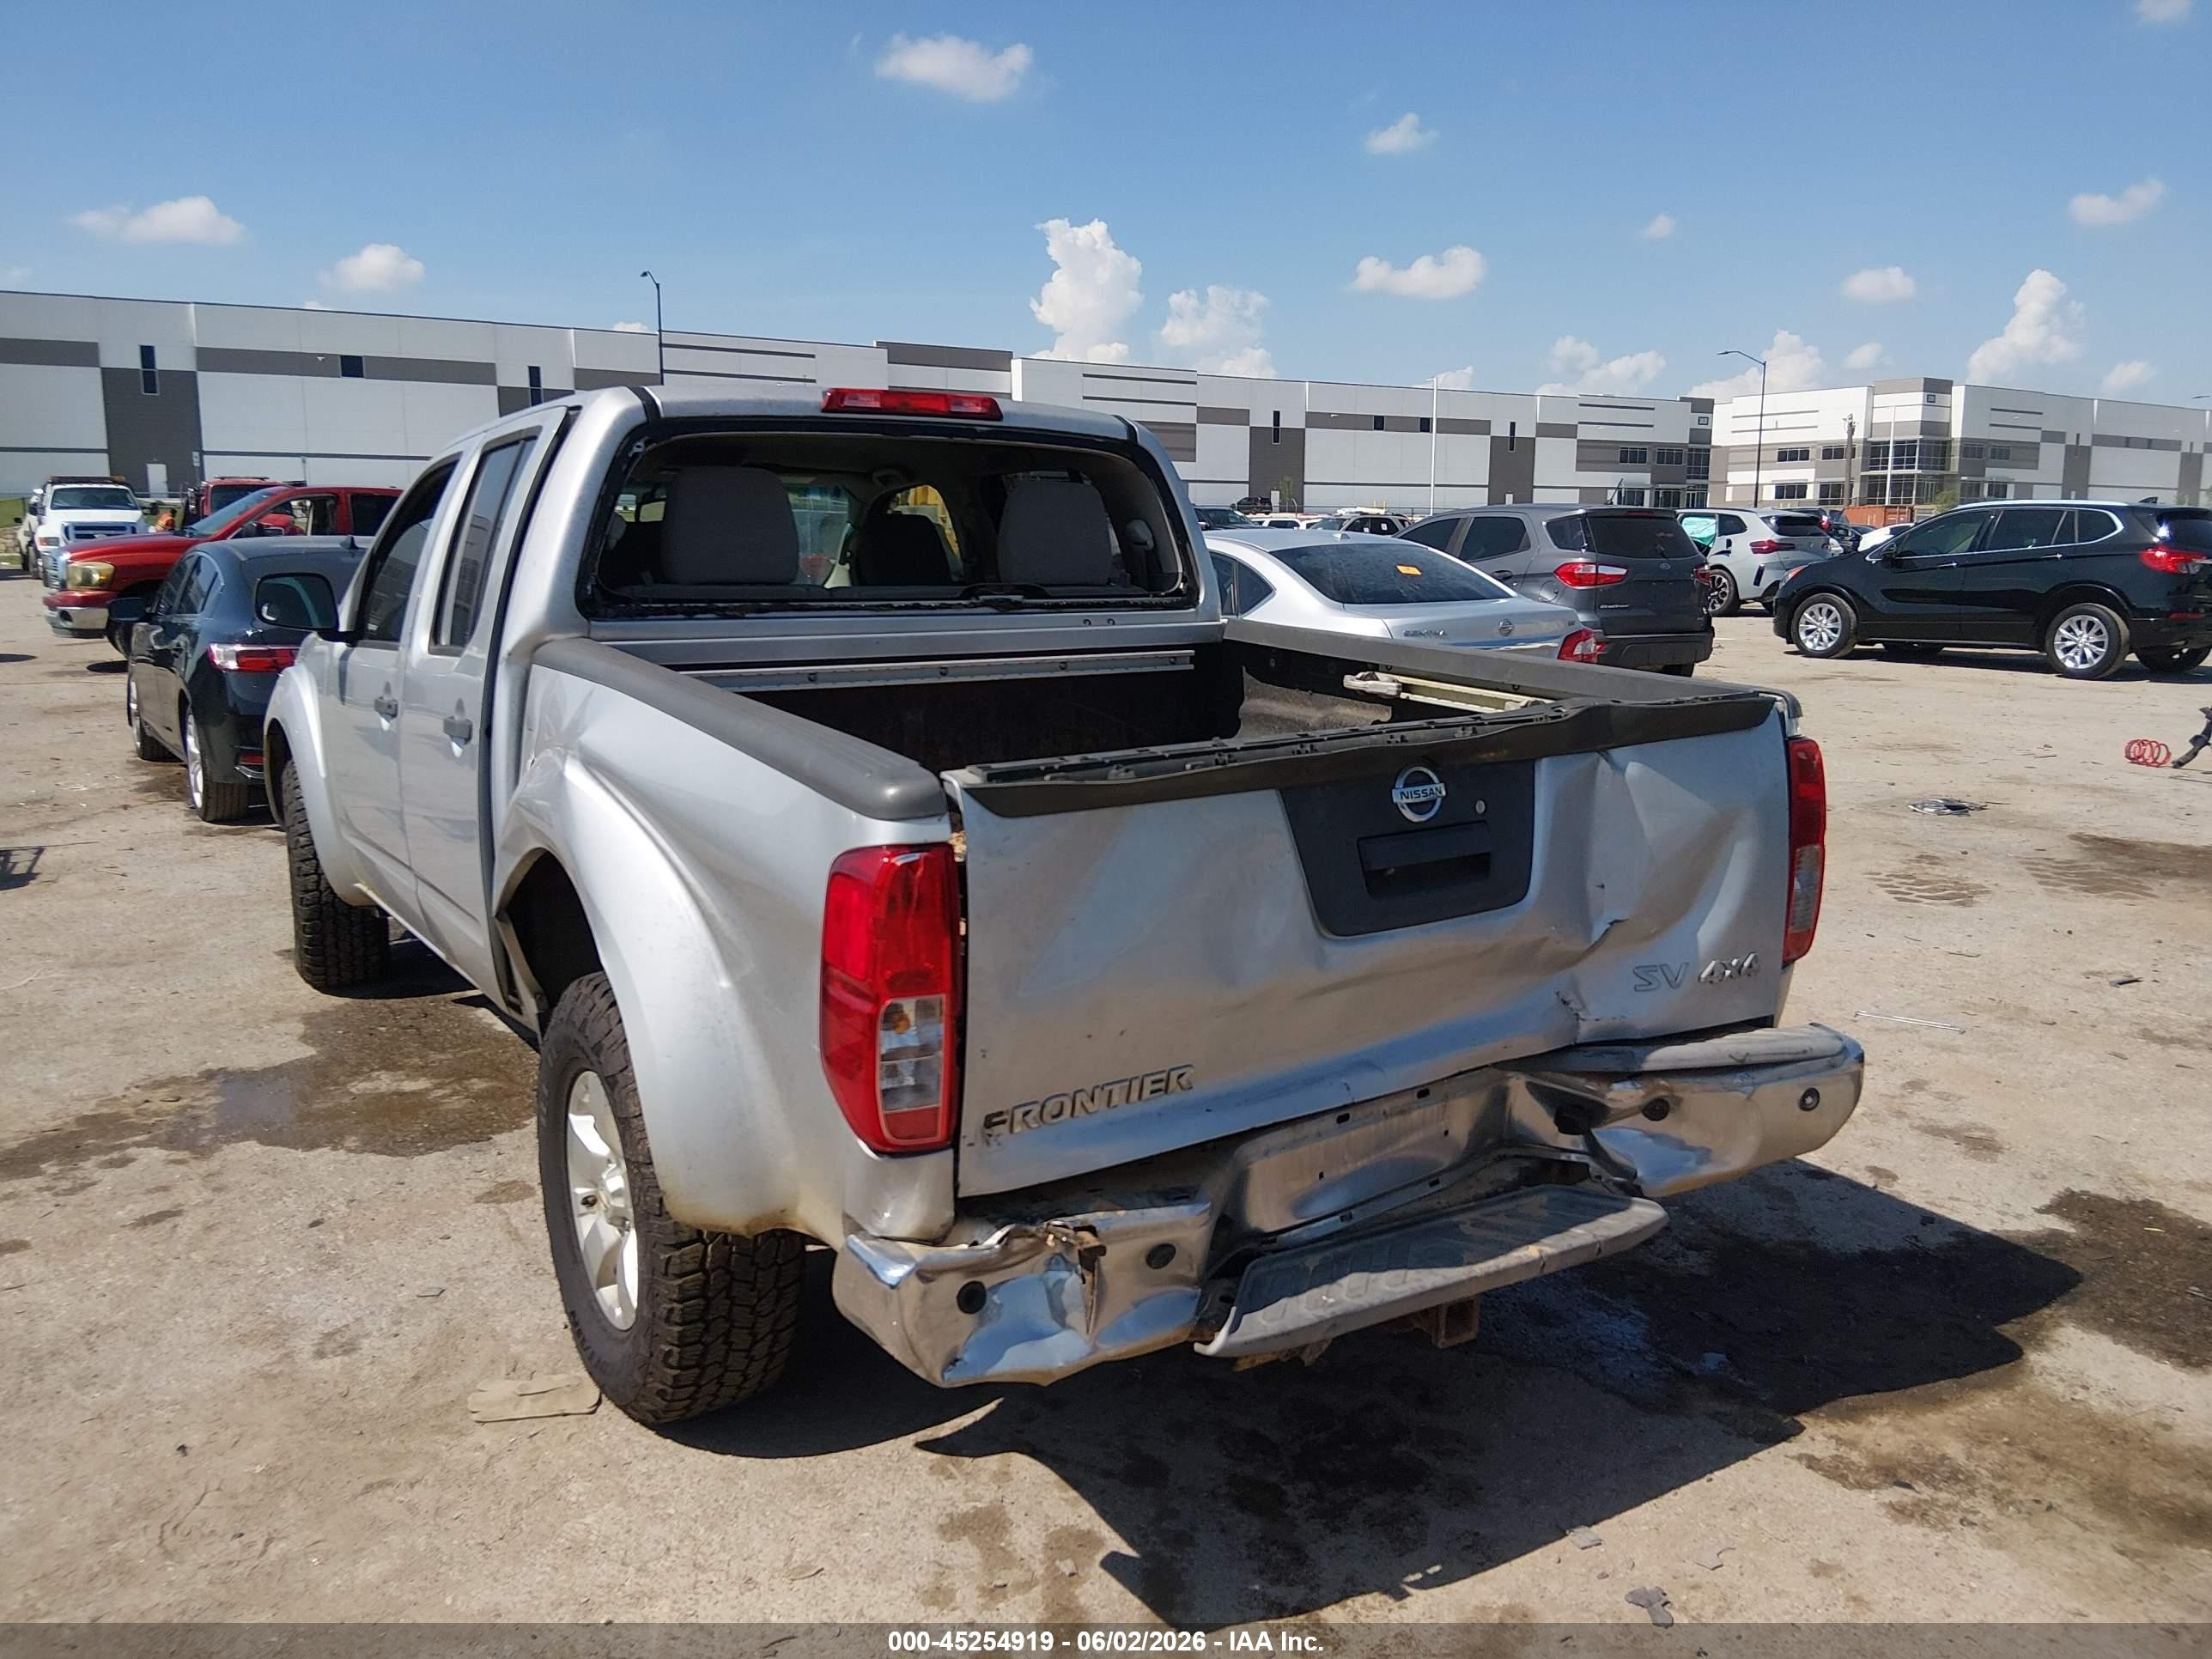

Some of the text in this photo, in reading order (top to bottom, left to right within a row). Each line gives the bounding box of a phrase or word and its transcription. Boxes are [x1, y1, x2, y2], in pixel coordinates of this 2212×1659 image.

[1400, 787, 1443, 800] NISSAN
[1632, 962, 1690, 993] SV
[982, 1064, 1195, 1136] FRONTIER
